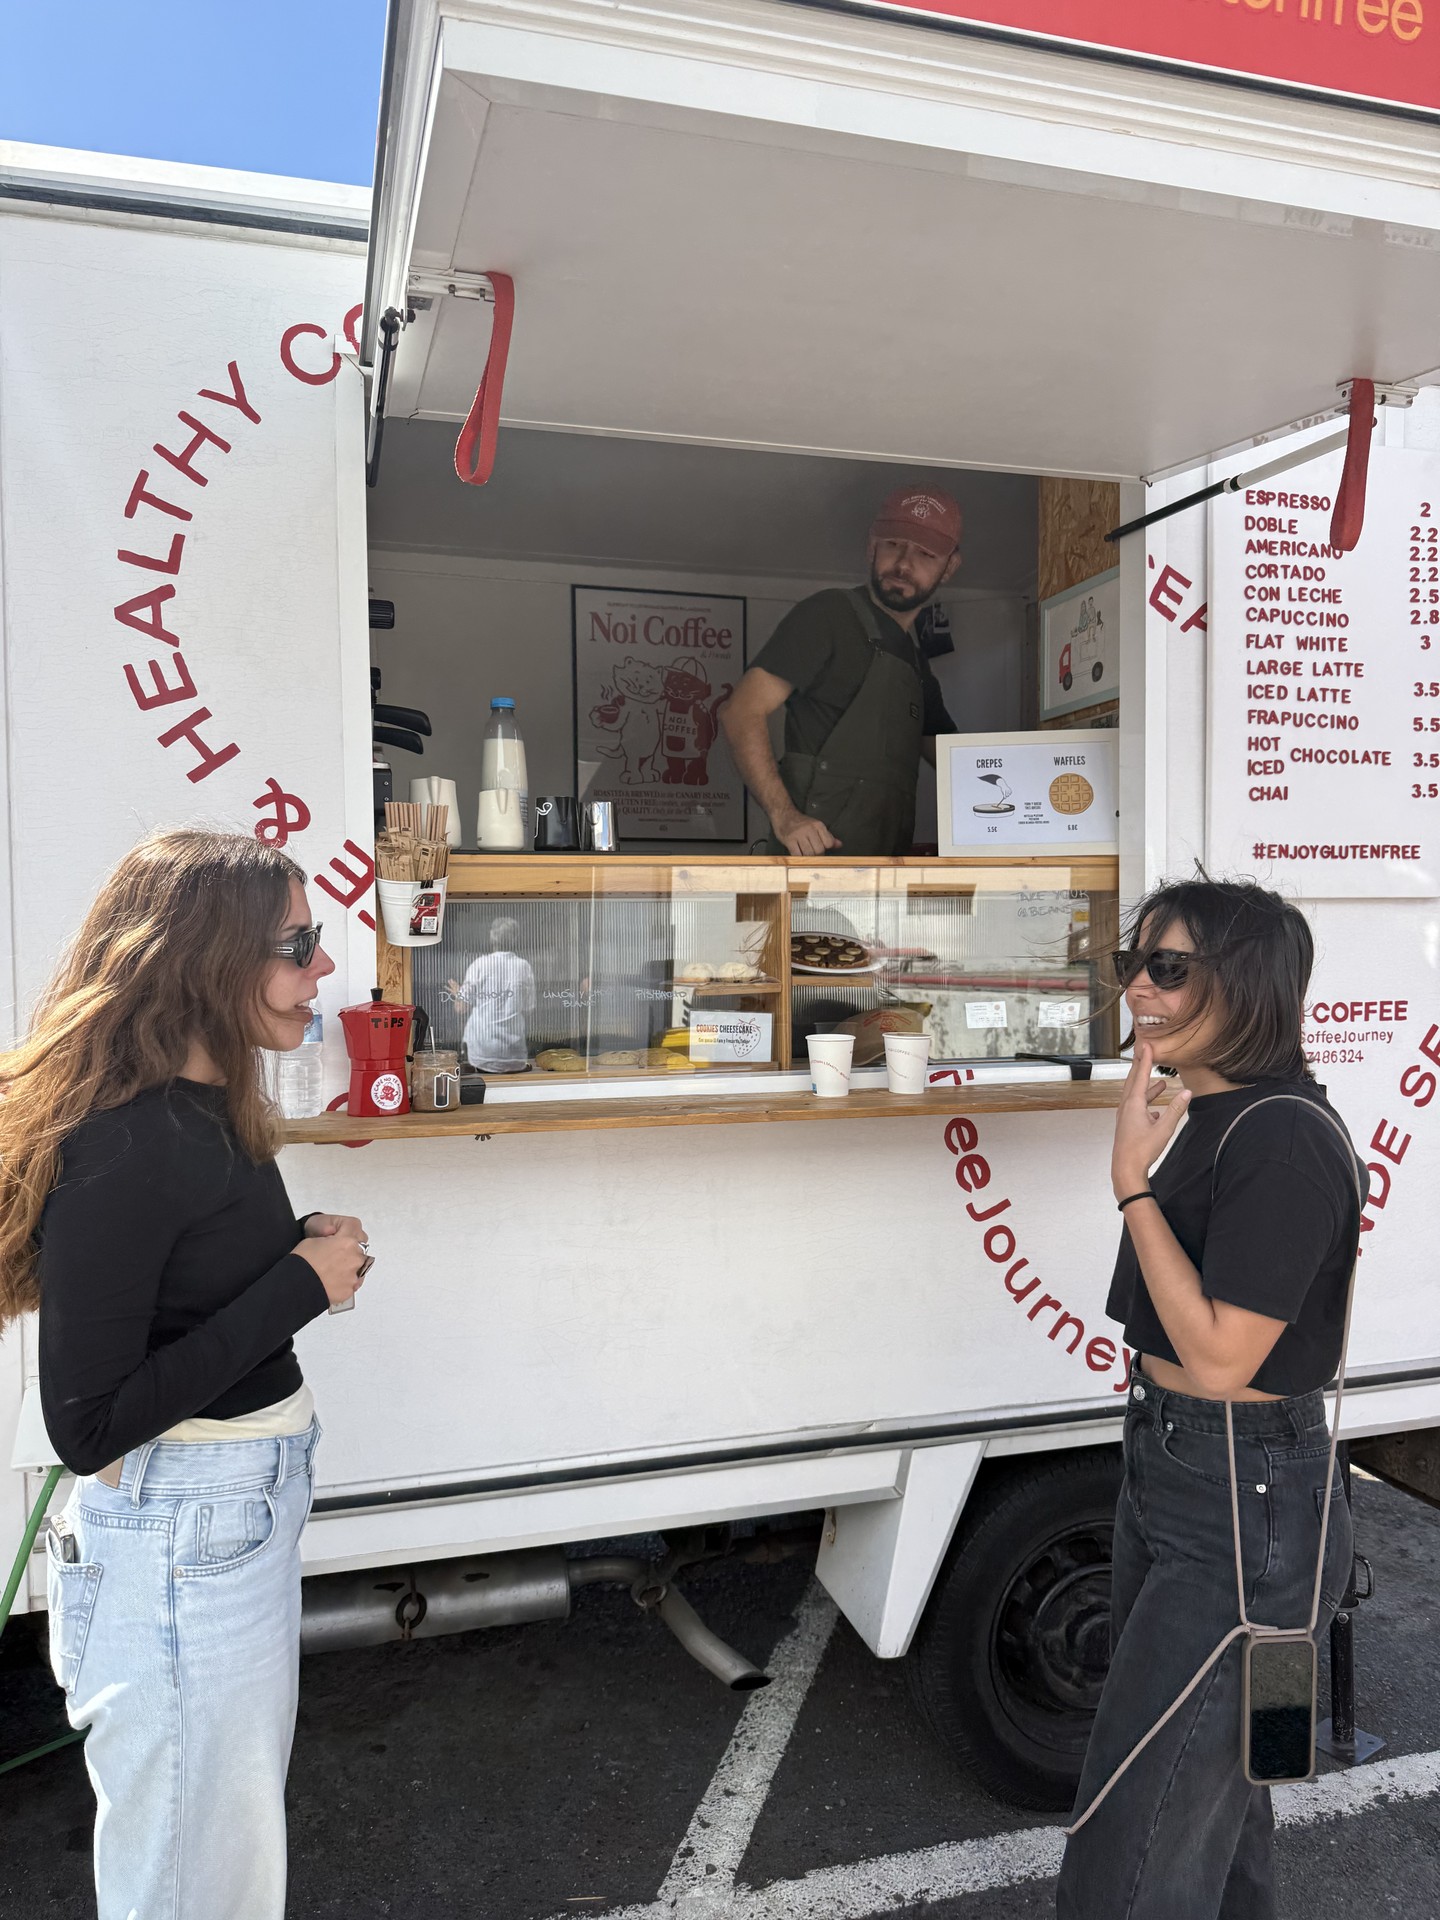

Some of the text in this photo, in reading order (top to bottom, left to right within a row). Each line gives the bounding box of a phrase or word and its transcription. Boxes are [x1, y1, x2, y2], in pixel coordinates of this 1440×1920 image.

[1245, 489, 1431, 518] ESPRESSO 2
[1245, 515, 1438, 543] DOBLE 2.2
[1245, 538, 1439, 563] AMERICANO 2.2
[113, 360, 262, 783] HEALTHY
[1245, 563, 1439, 583] CORTADO 2.2
[1244, 585, 1440, 604] CON LECHE 2.5
[1246, 607, 1440, 628] CAPUCCINO 2.8
[589, 611, 733, 649] Noi Coffee
[1246, 633, 1431, 652] FLAT WHITE 3
[1246, 660, 1364, 677] LARGE LATTE
[1247, 682, 1440, 704] ICED LATTE 3.5
[663, 723, 697, 736] COFFEE
[669, 716, 687, 724] NOI
[1247, 709, 1440, 732] FRAPUCCINO 5.5
[1247, 736, 1281, 751] HOT
[976, 755, 1086, 769] CREPES WAFFLES
[1247, 759, 1285, 776] ICED
[1290, 748, 1440, 768] CHOCOLATE 3.5
[1249, 783, 1439, 801] CHAI 3.5
[1252, 843, 1421, 859] #ENJOYGLUTENFREE
[1312, 1000, 1408, 1024] COFFEE
[696, 1024, 752, 1034] COOKIES CHEESECAKE
